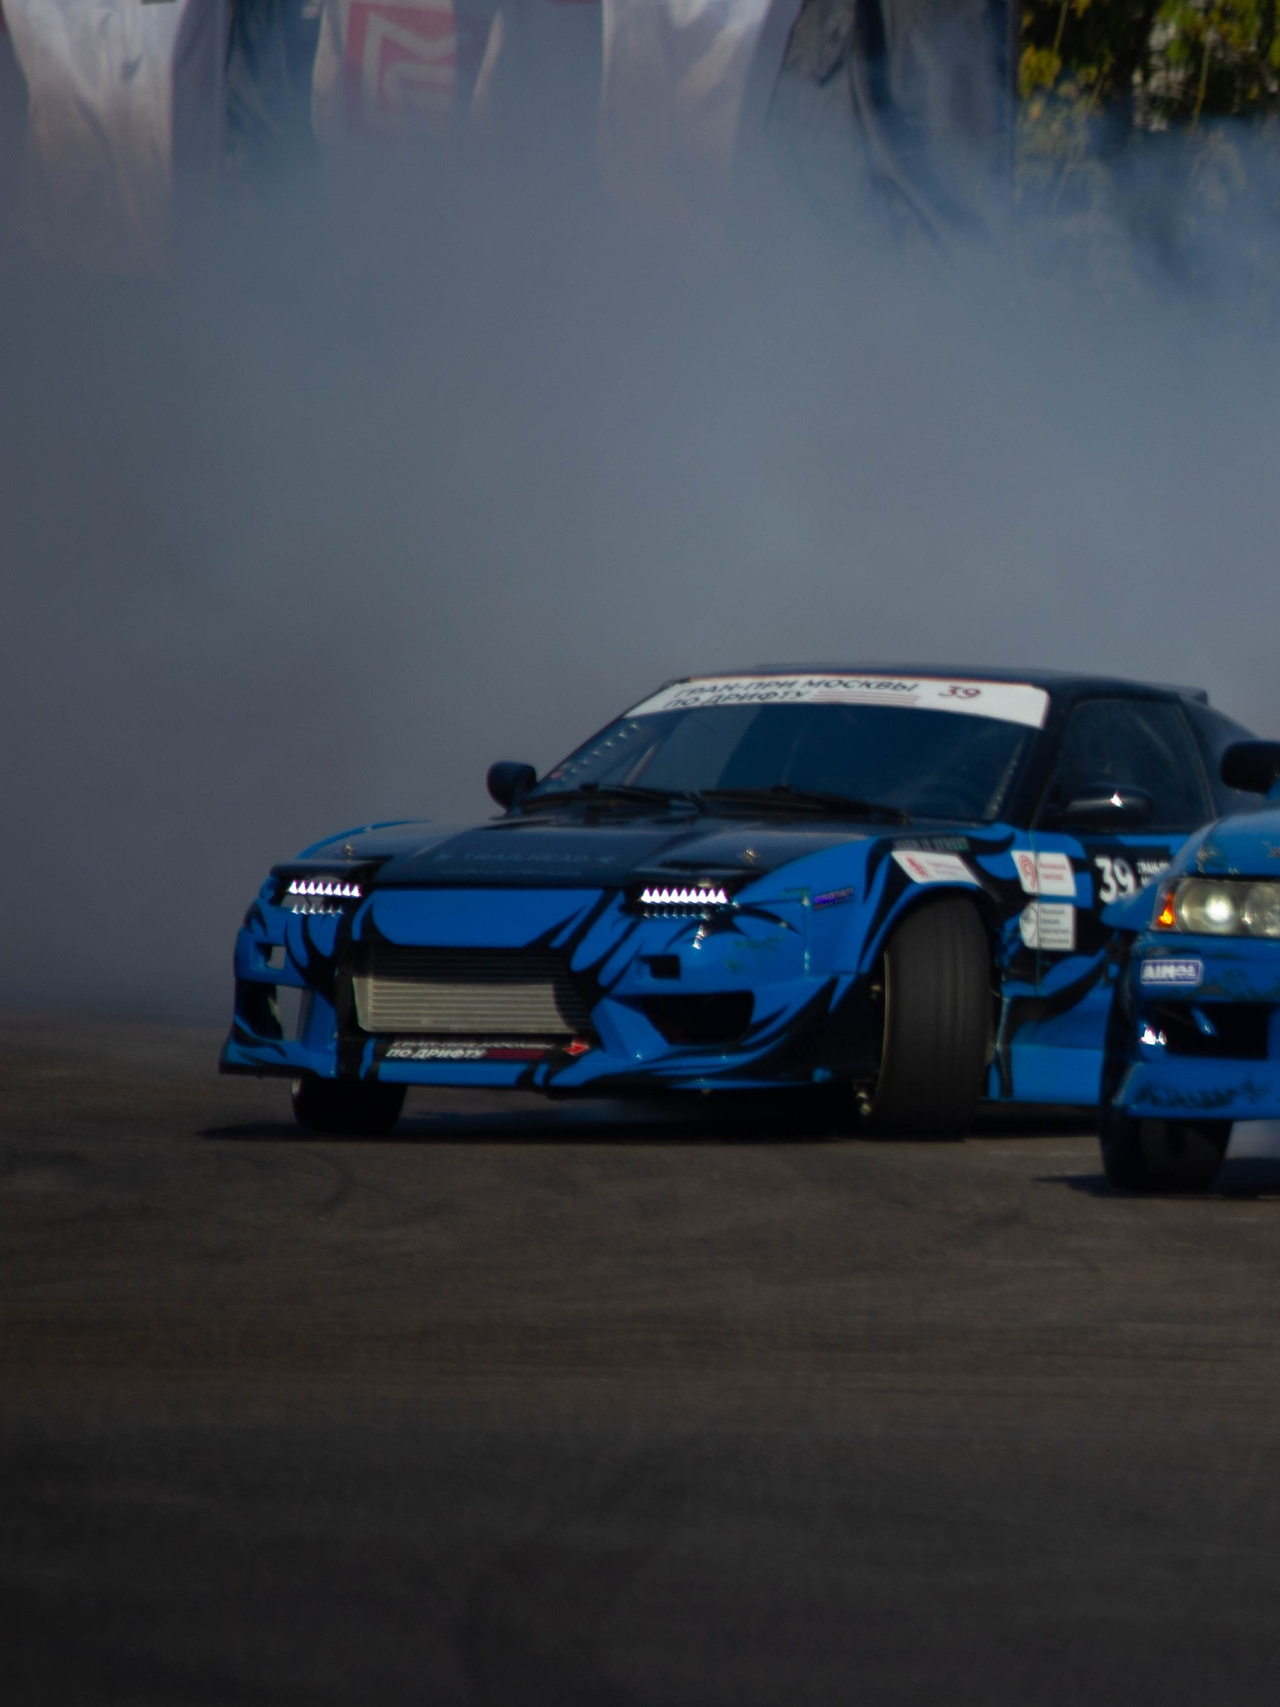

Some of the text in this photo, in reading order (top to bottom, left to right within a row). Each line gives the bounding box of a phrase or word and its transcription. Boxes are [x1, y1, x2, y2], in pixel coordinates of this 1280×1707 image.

[674, 679, 919, 699] ГРАН-ПРИ МОСКВЫ
[938, 685, 982, 699] 39
[663, 690, 811, 709] ПО ДРИФТУ
[1094, 854, 1135, 904] 39
[385, 1048, 487, 1060] ПО ДРИФТУ
